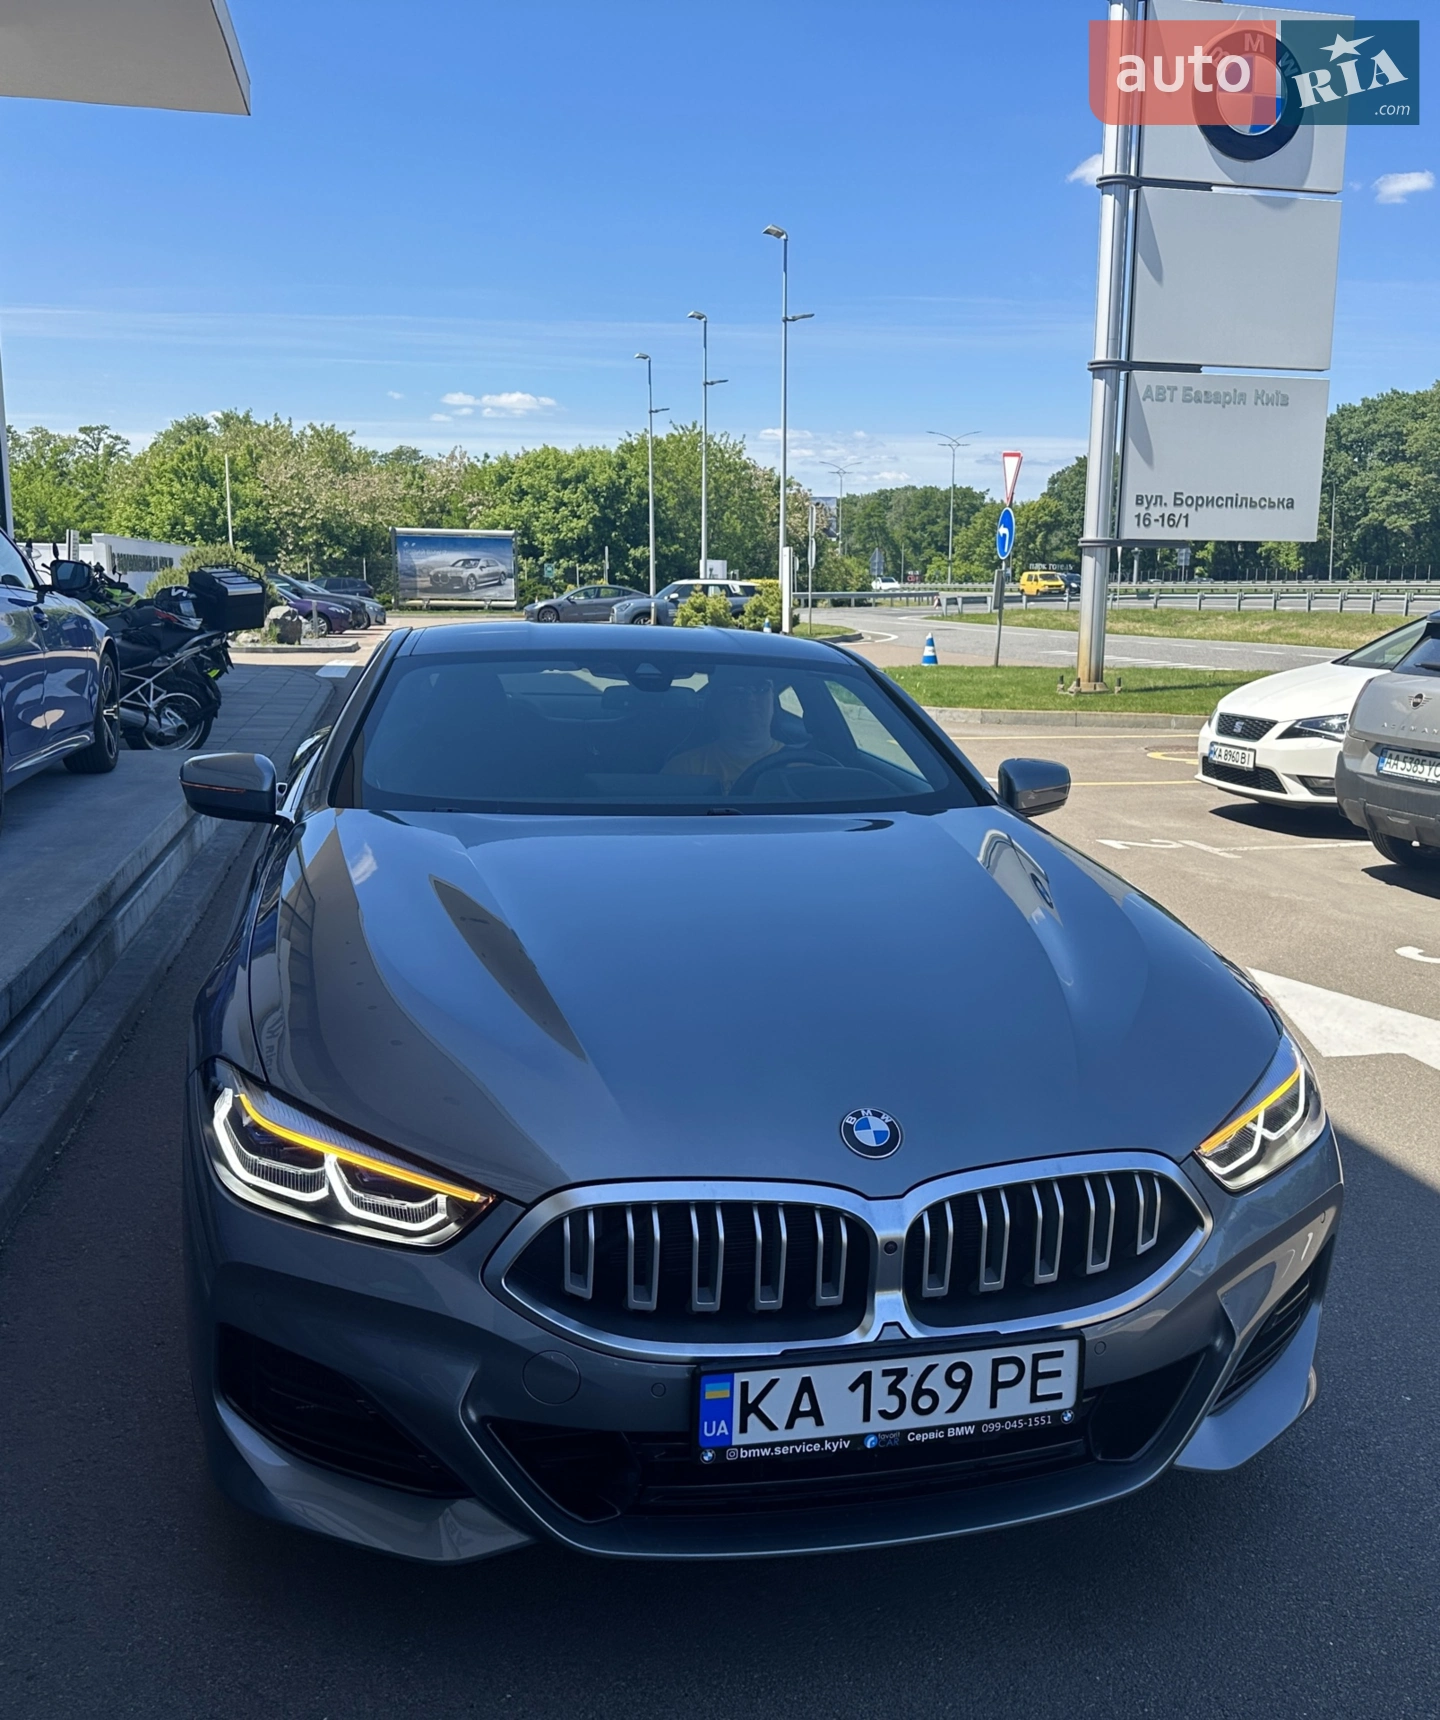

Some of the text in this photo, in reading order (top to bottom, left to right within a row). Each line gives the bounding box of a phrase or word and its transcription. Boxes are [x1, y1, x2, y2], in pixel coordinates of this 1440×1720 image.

[1142, 384, 1178, 403] АВТ
[1254, 388, 1290, 407] Київ
[1135, 491, 1295, 512] вул. Бориспільська
[1223, 748, 1240, 764] 8960
[1384, 752, 1400, 770] AA
[1400, 755, 1427, 775] 5385
[845, 1109, 893, 1125] BMW
[739, 1349, 1065, 1435] KA 1369 PE
[703, 1419, 730, 1437] UA
[981, 1415, 1052, 1433] 099-045-1551
[907, 1425, 976, 1443] Сервіс BMW
[739, 1438, 851, 1460] bmw.service.kyiv
